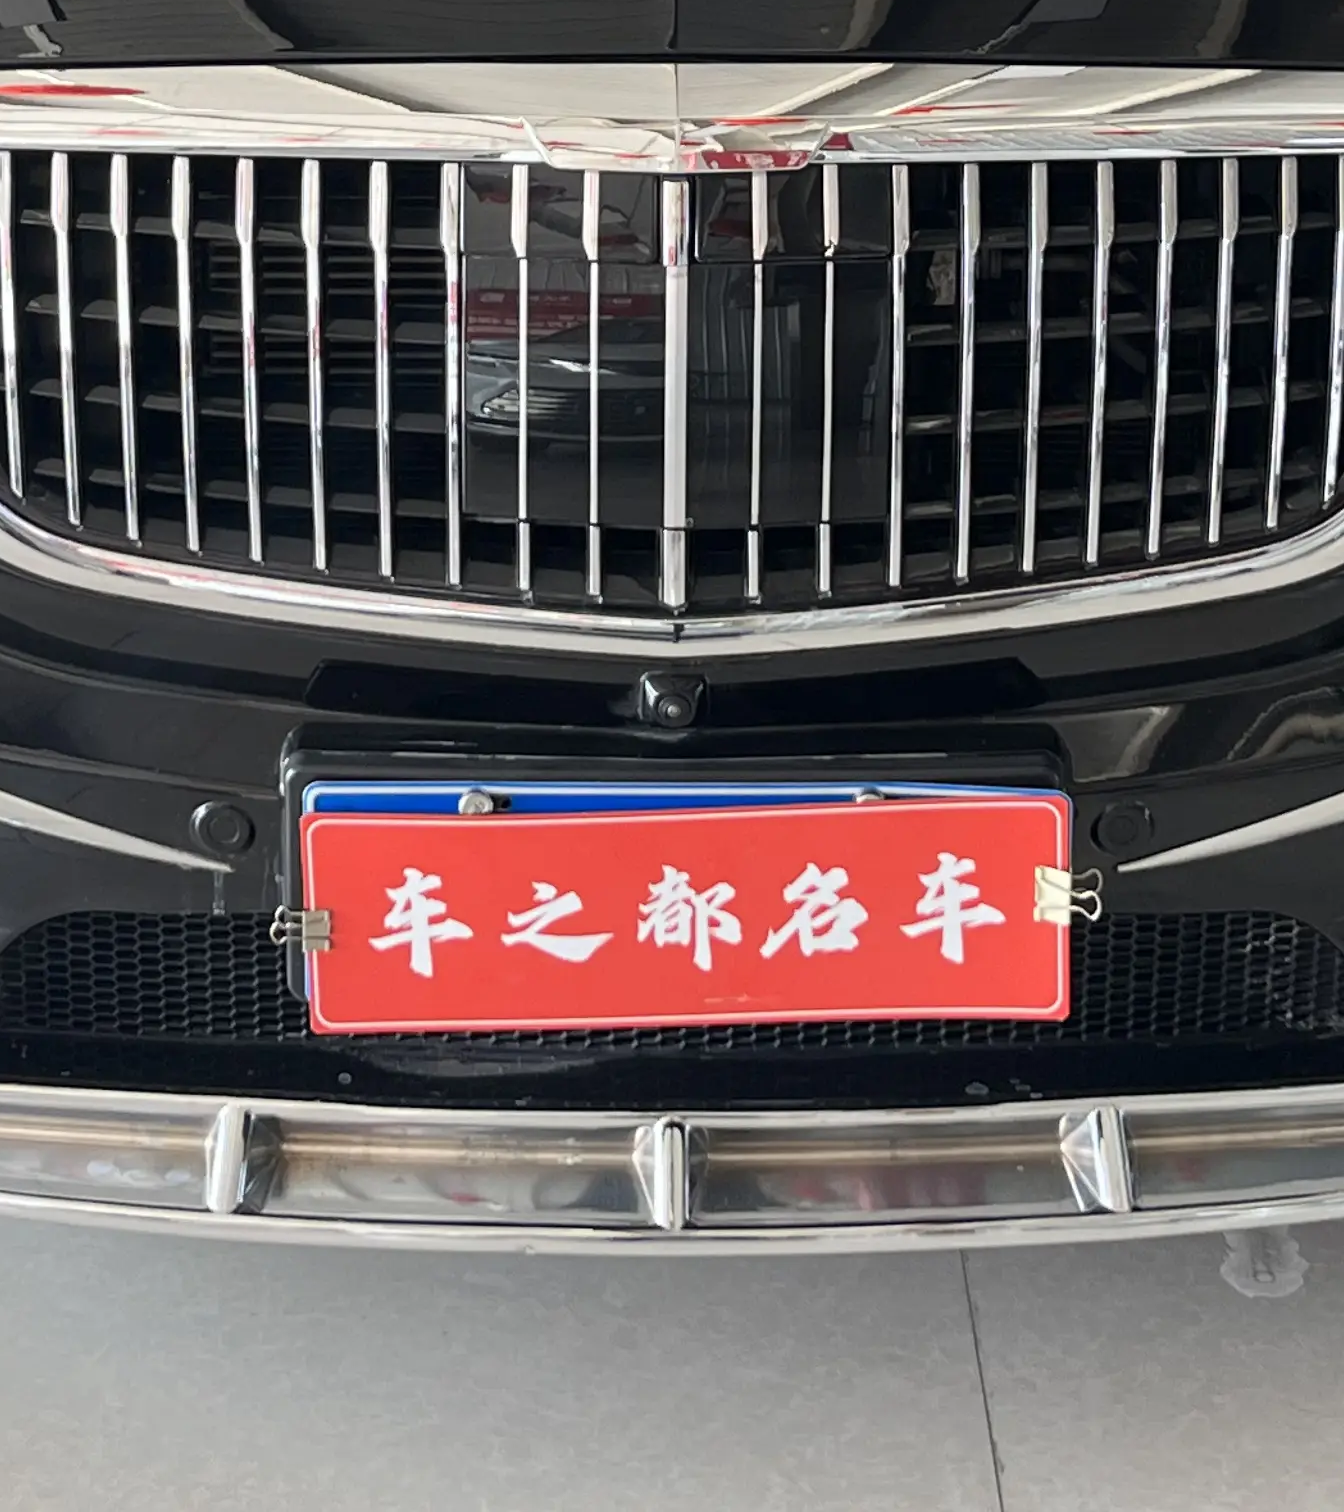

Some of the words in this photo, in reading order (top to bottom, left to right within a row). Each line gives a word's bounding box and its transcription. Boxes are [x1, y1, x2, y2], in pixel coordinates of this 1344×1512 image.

[368, 852, 1008, 979] 车之都名车
